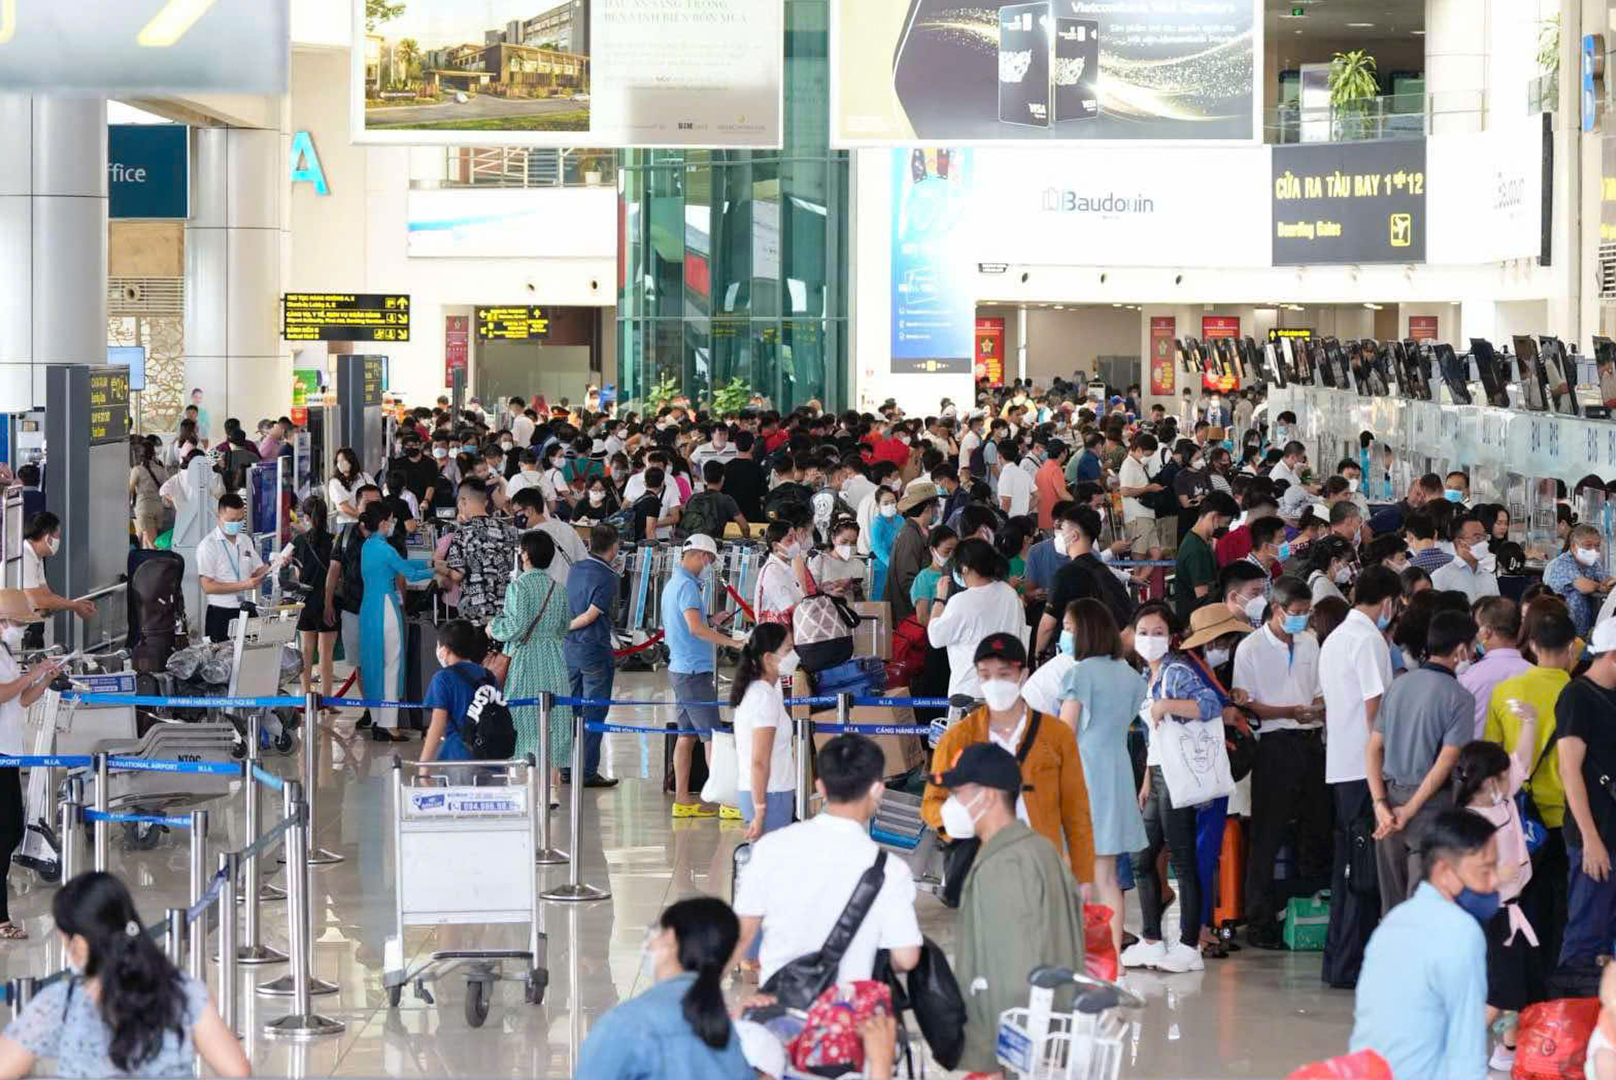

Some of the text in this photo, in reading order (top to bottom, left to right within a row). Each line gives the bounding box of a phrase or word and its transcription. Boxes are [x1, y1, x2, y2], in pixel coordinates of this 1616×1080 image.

[289, 131, 329, 197] A
[1276, 171, 1301, 199] CỬA
[1305, 177, 1322, 198] RA
[1326, 171, 1350, 197] TÀU
[1354, 174, 1380, 197] BAY
[1062, 190, 1154, 212] Baudouin
[1277, 220, 1341, 240] Boarding Gates
[108, 760, 149, 769] TERNATIONAL
[151, 763, 177, 771] AIRPORT
